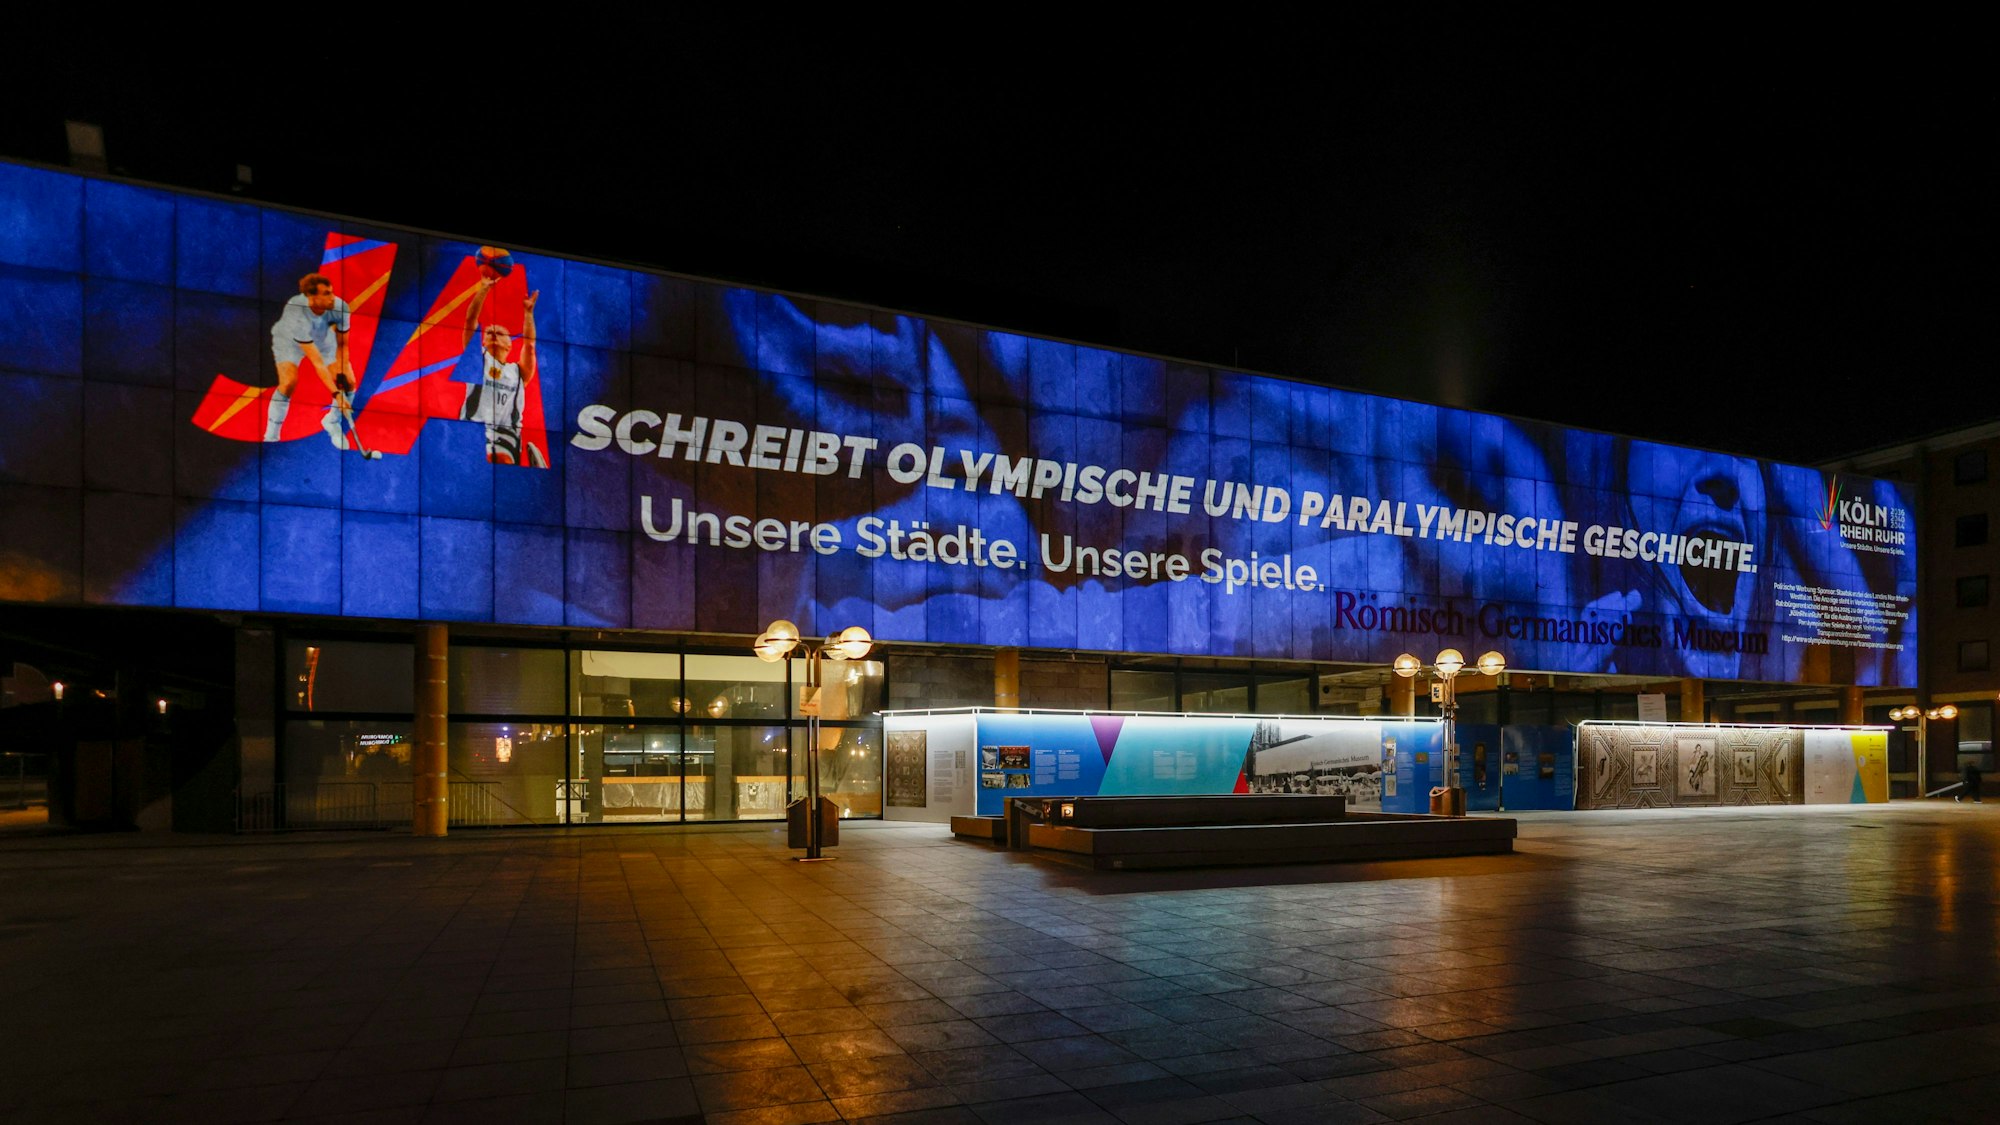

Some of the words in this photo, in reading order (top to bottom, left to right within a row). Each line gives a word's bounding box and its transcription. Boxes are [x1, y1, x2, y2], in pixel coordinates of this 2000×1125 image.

[192, 232, 550, 469] JA
[497, 391, 508, 406] 10
[570, 404, 877, 479] SCHREIBT
[886, 442, 1195, 514] OLYMPISCHE
[1203, 479, 1291, 525] UND
[1298, 491, 1579, 553] PARALYMPISCHE
[1583, 524, 1758, 573] GESCHICHTE.
[1840, 496, 1887, 527] KÖLN
[640, 496, 842, 556] Unsere
[856, 516, 1028, 571] Städte.
[1040, 533, 1190, 582] Unsere
[1200, 547, 1325, 595] Spiele.
[1840, 524, 1872, 541] RHEIN
[1875, 529, 1906, 545] RUHR
[1840, 542, 1856, 550] Unsere
[1874, 545, 1890, 554] Unsere
[1334, 590, 1662, 648] Römisch-Germanisches
[1673, 619, 1768, 655] Museum
